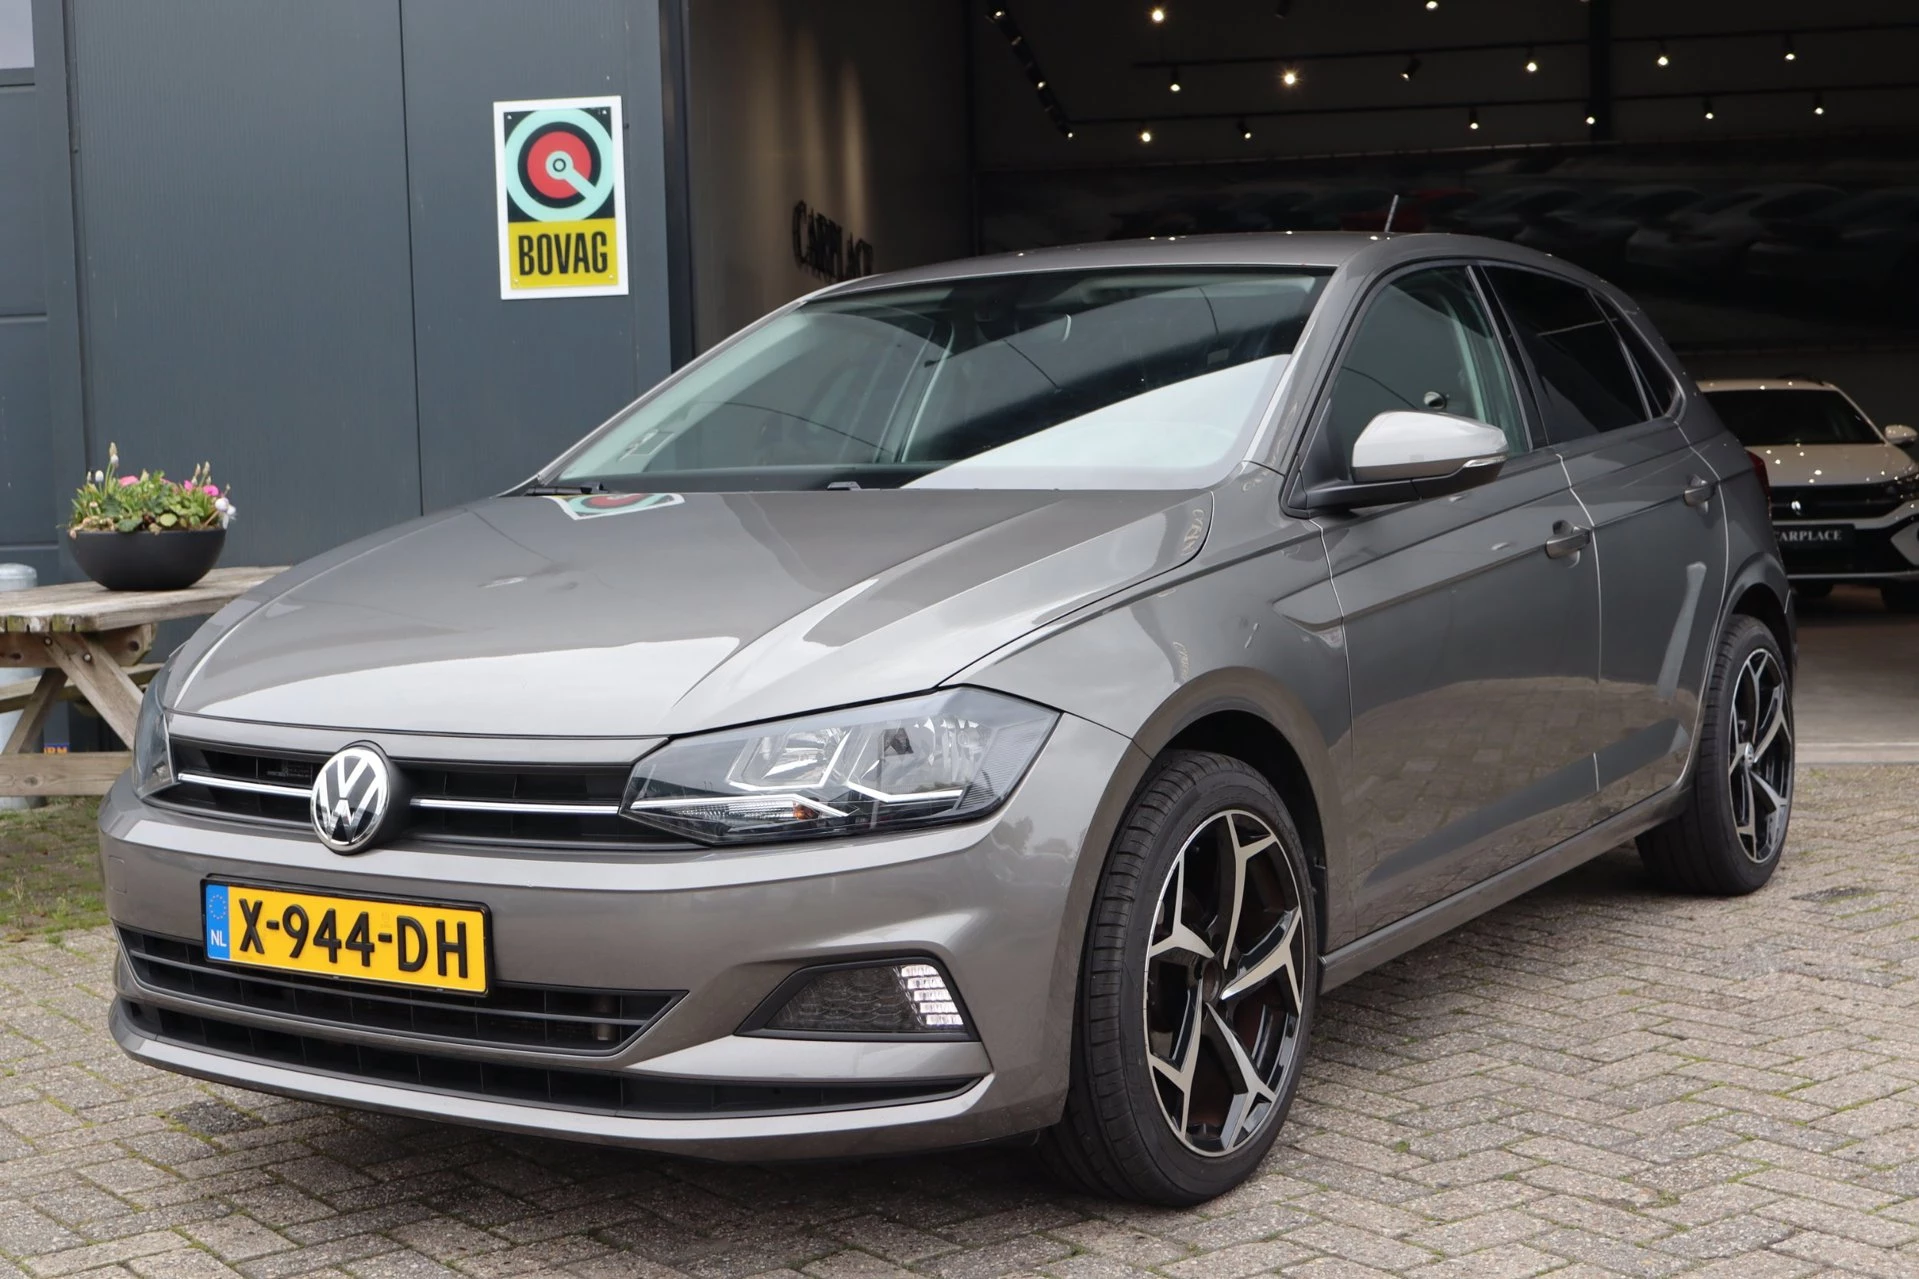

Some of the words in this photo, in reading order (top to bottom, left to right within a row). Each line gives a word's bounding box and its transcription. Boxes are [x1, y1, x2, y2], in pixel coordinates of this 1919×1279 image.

[518, 231, 608, 277] BOVAG
[1774, 529, 1842, 543] ARPLACE
[210, 929, 227, 948] NL
[238, 898, 469, 979] X-944-DH
